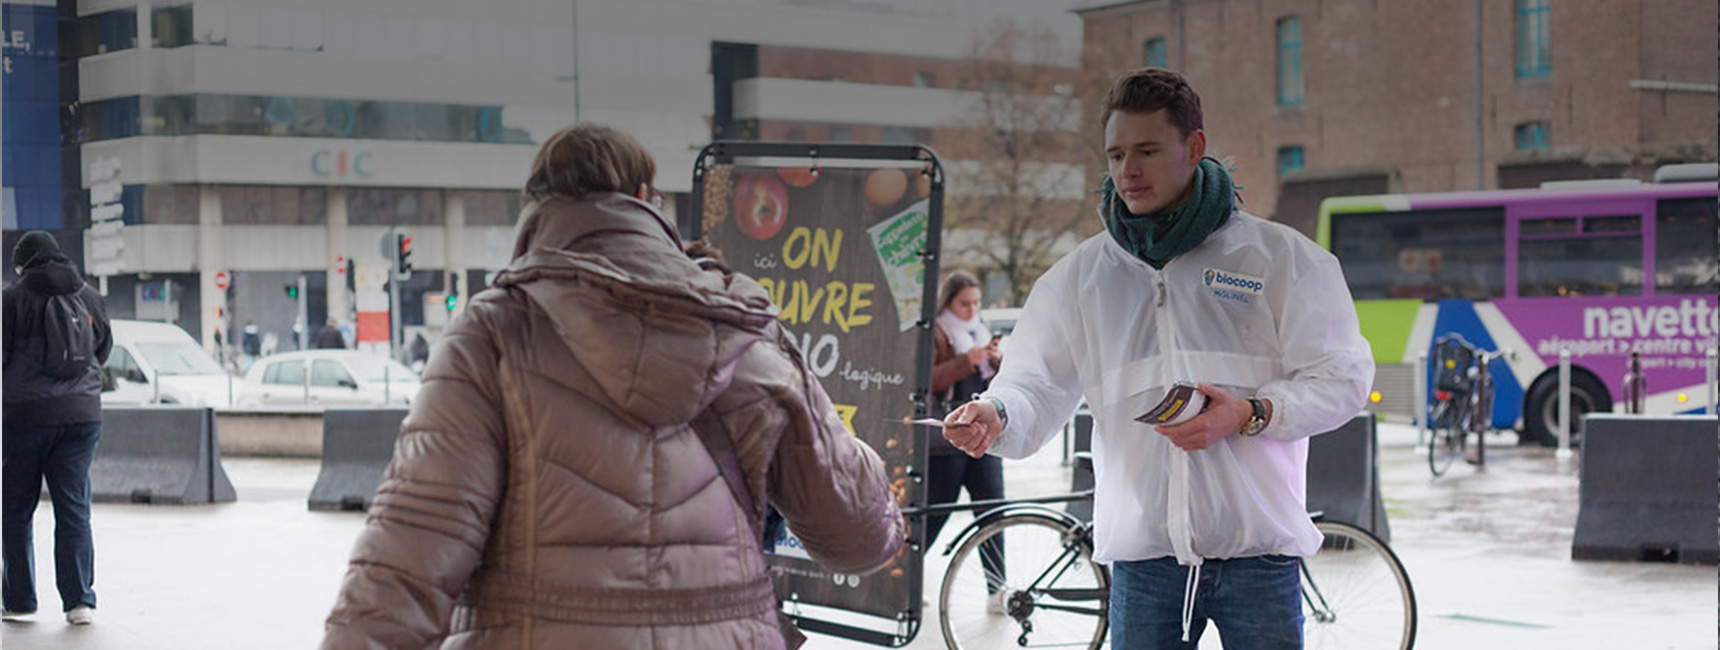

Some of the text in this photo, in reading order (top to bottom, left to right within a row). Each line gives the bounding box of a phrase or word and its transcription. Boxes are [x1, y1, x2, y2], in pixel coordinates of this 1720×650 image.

[310, 149, 374, 177] CIC
[753, 226, 844, 273] ici ON
[1216, 271, 1263, 292] biocoop
[785, 331, 840, 378] IO
